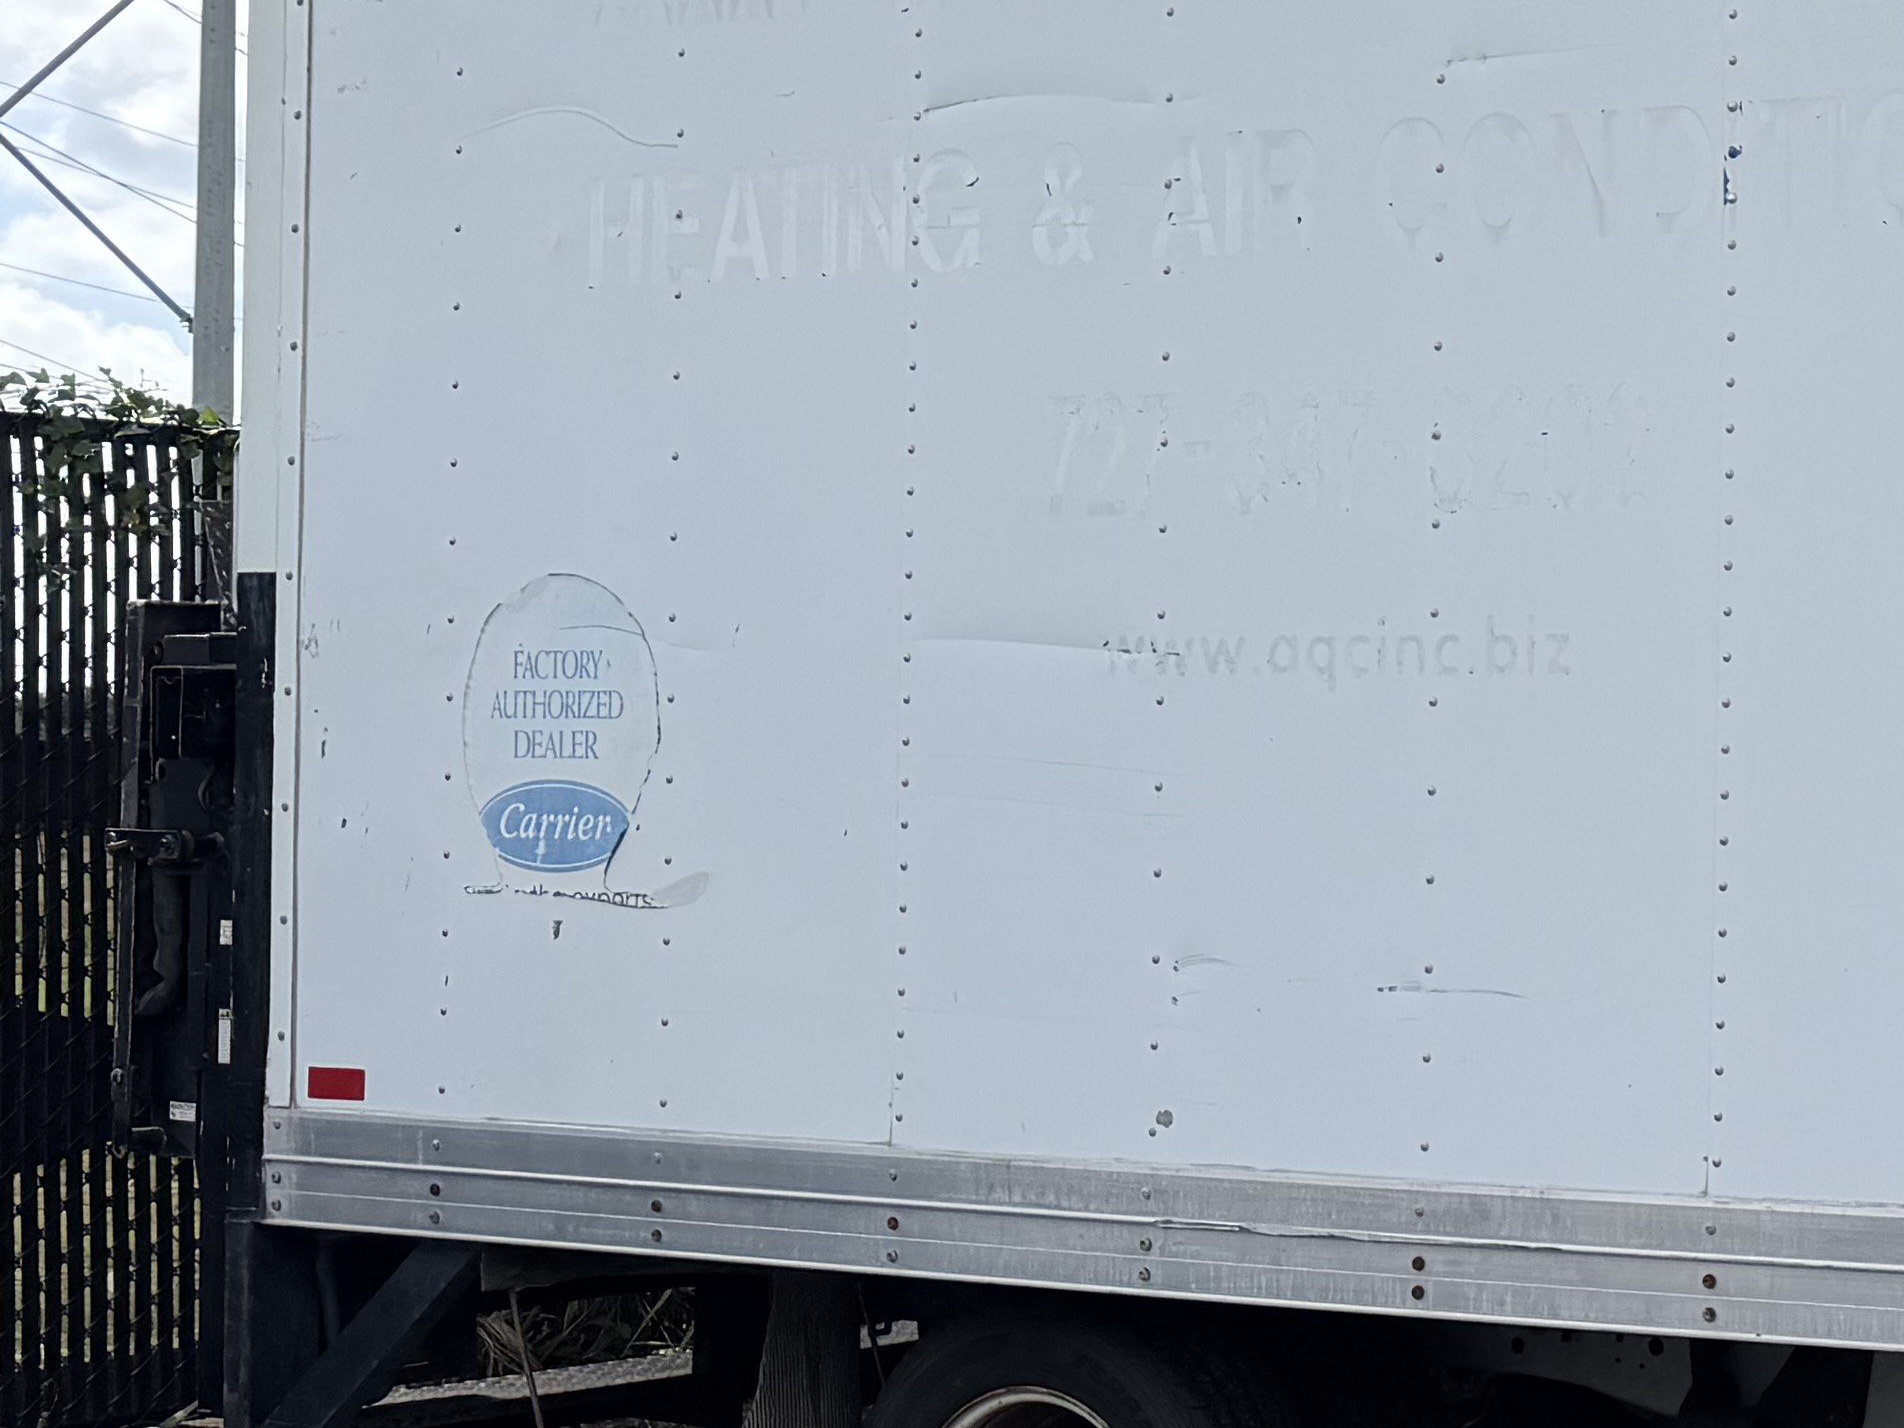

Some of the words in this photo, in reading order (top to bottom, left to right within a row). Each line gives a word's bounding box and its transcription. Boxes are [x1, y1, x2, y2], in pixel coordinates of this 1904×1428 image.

[588, 147, 980, 289] HEATING
[1032, 142, 1096, 266] &
[1152, 128, 1316, 259] AIR
[513, 649, 602, 679] FACTORY
[490, 689, 624, 720] AUTHORIZED
[513, 729, 599, 760] DEALER
[499, 803, 613, 840] Carrier
